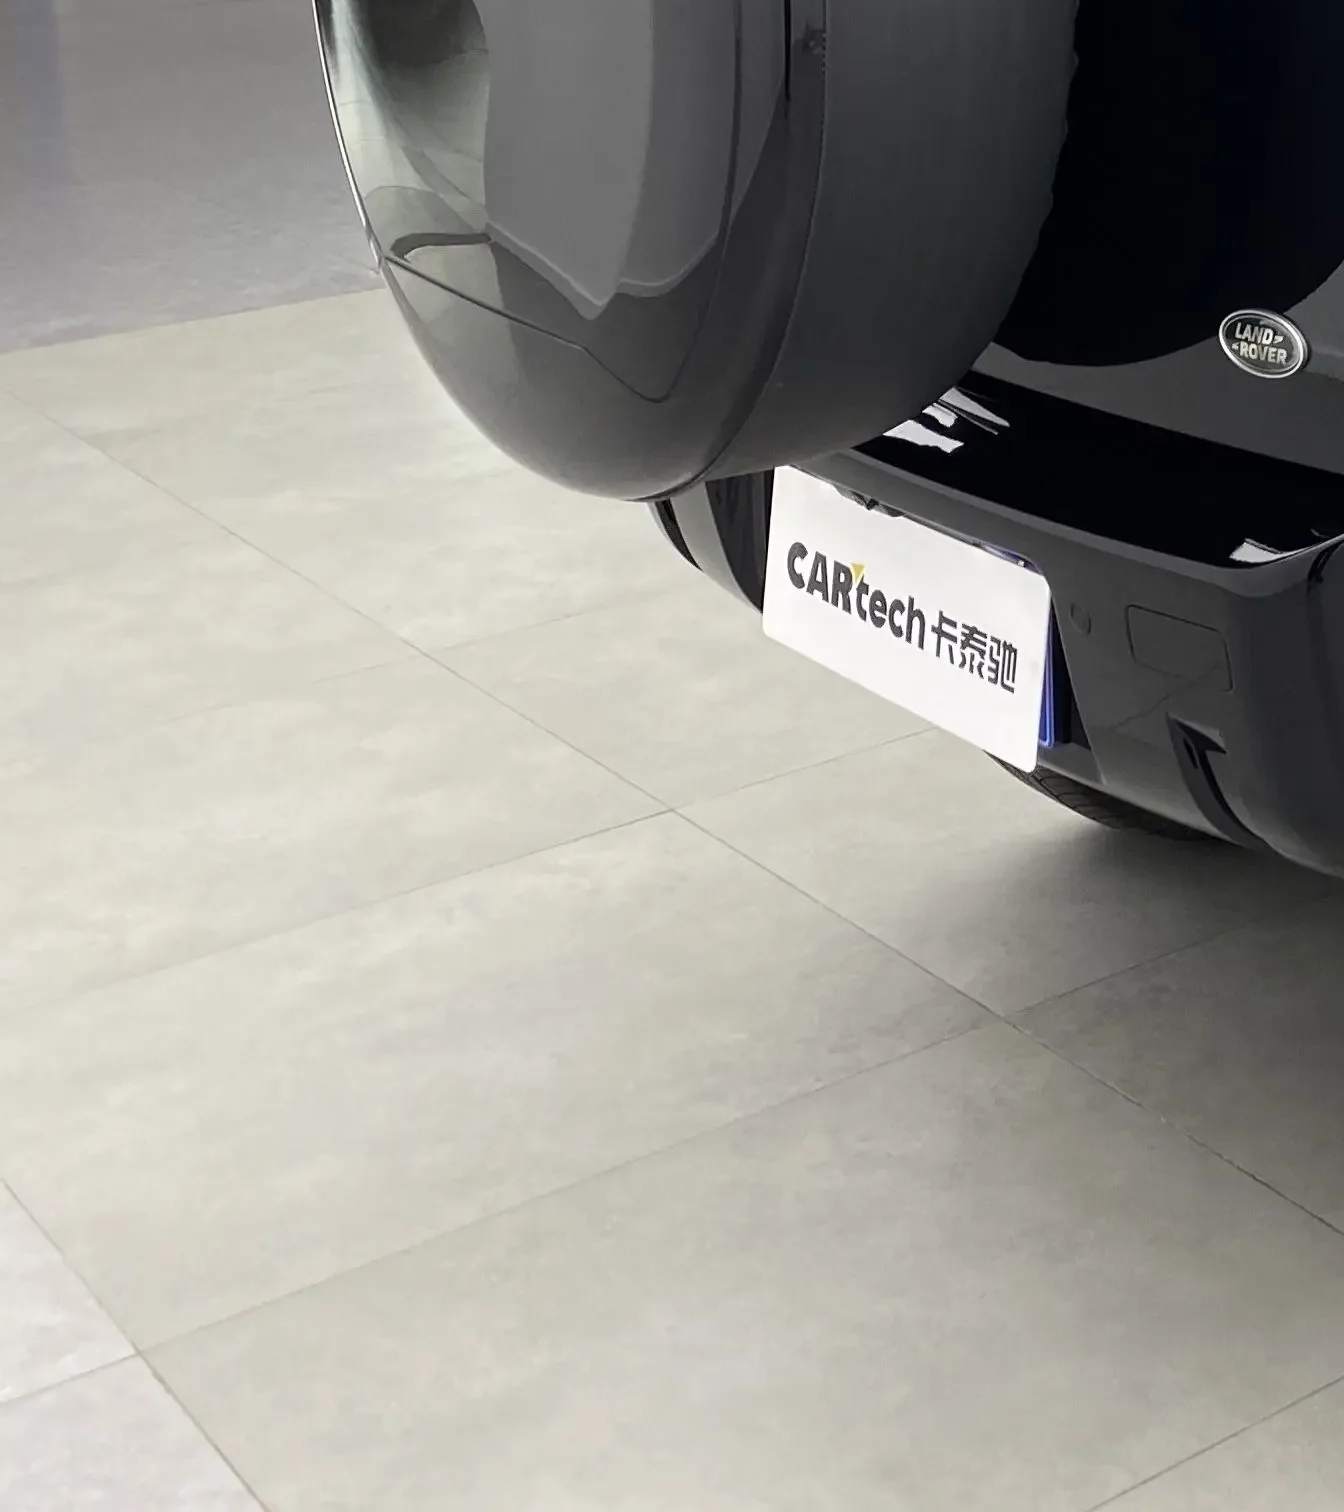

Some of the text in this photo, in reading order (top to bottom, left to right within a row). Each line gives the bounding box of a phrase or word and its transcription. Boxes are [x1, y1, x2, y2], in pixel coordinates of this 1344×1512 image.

[1234, 321, 1274, 345] LAND
[1239, 341, 1288, 366] ROVER
[786, 541, 1019, 694] CARtech 卡泰驰
